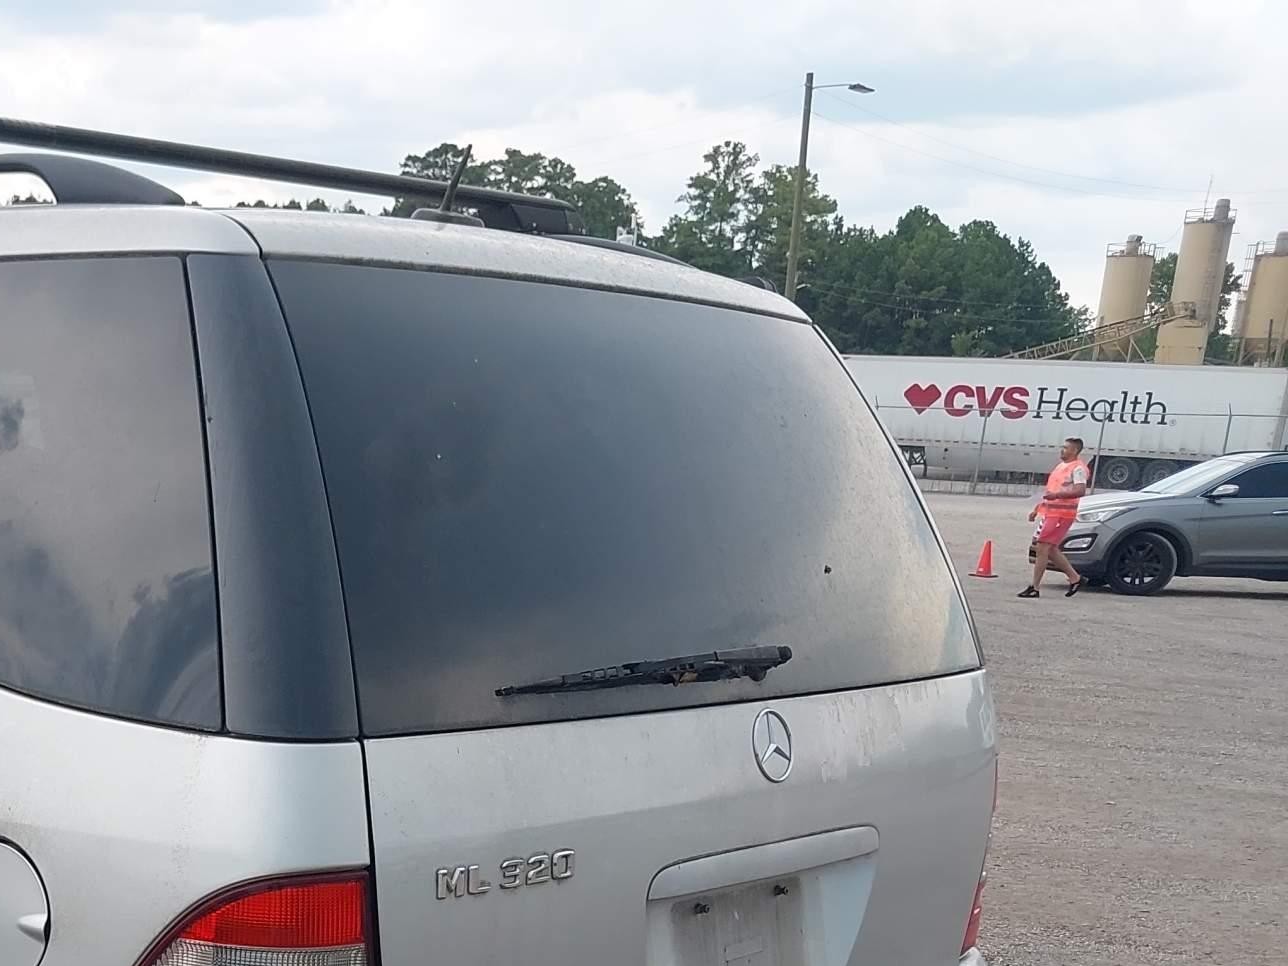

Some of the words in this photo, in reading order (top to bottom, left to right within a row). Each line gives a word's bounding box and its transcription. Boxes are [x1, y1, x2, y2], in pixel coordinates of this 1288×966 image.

[943, 384, 1030, 420] CVS
[1031, 387, 1168, 426] Health
[436, 865, 492, 900] ML
[499, 848, 576, 890] 320
